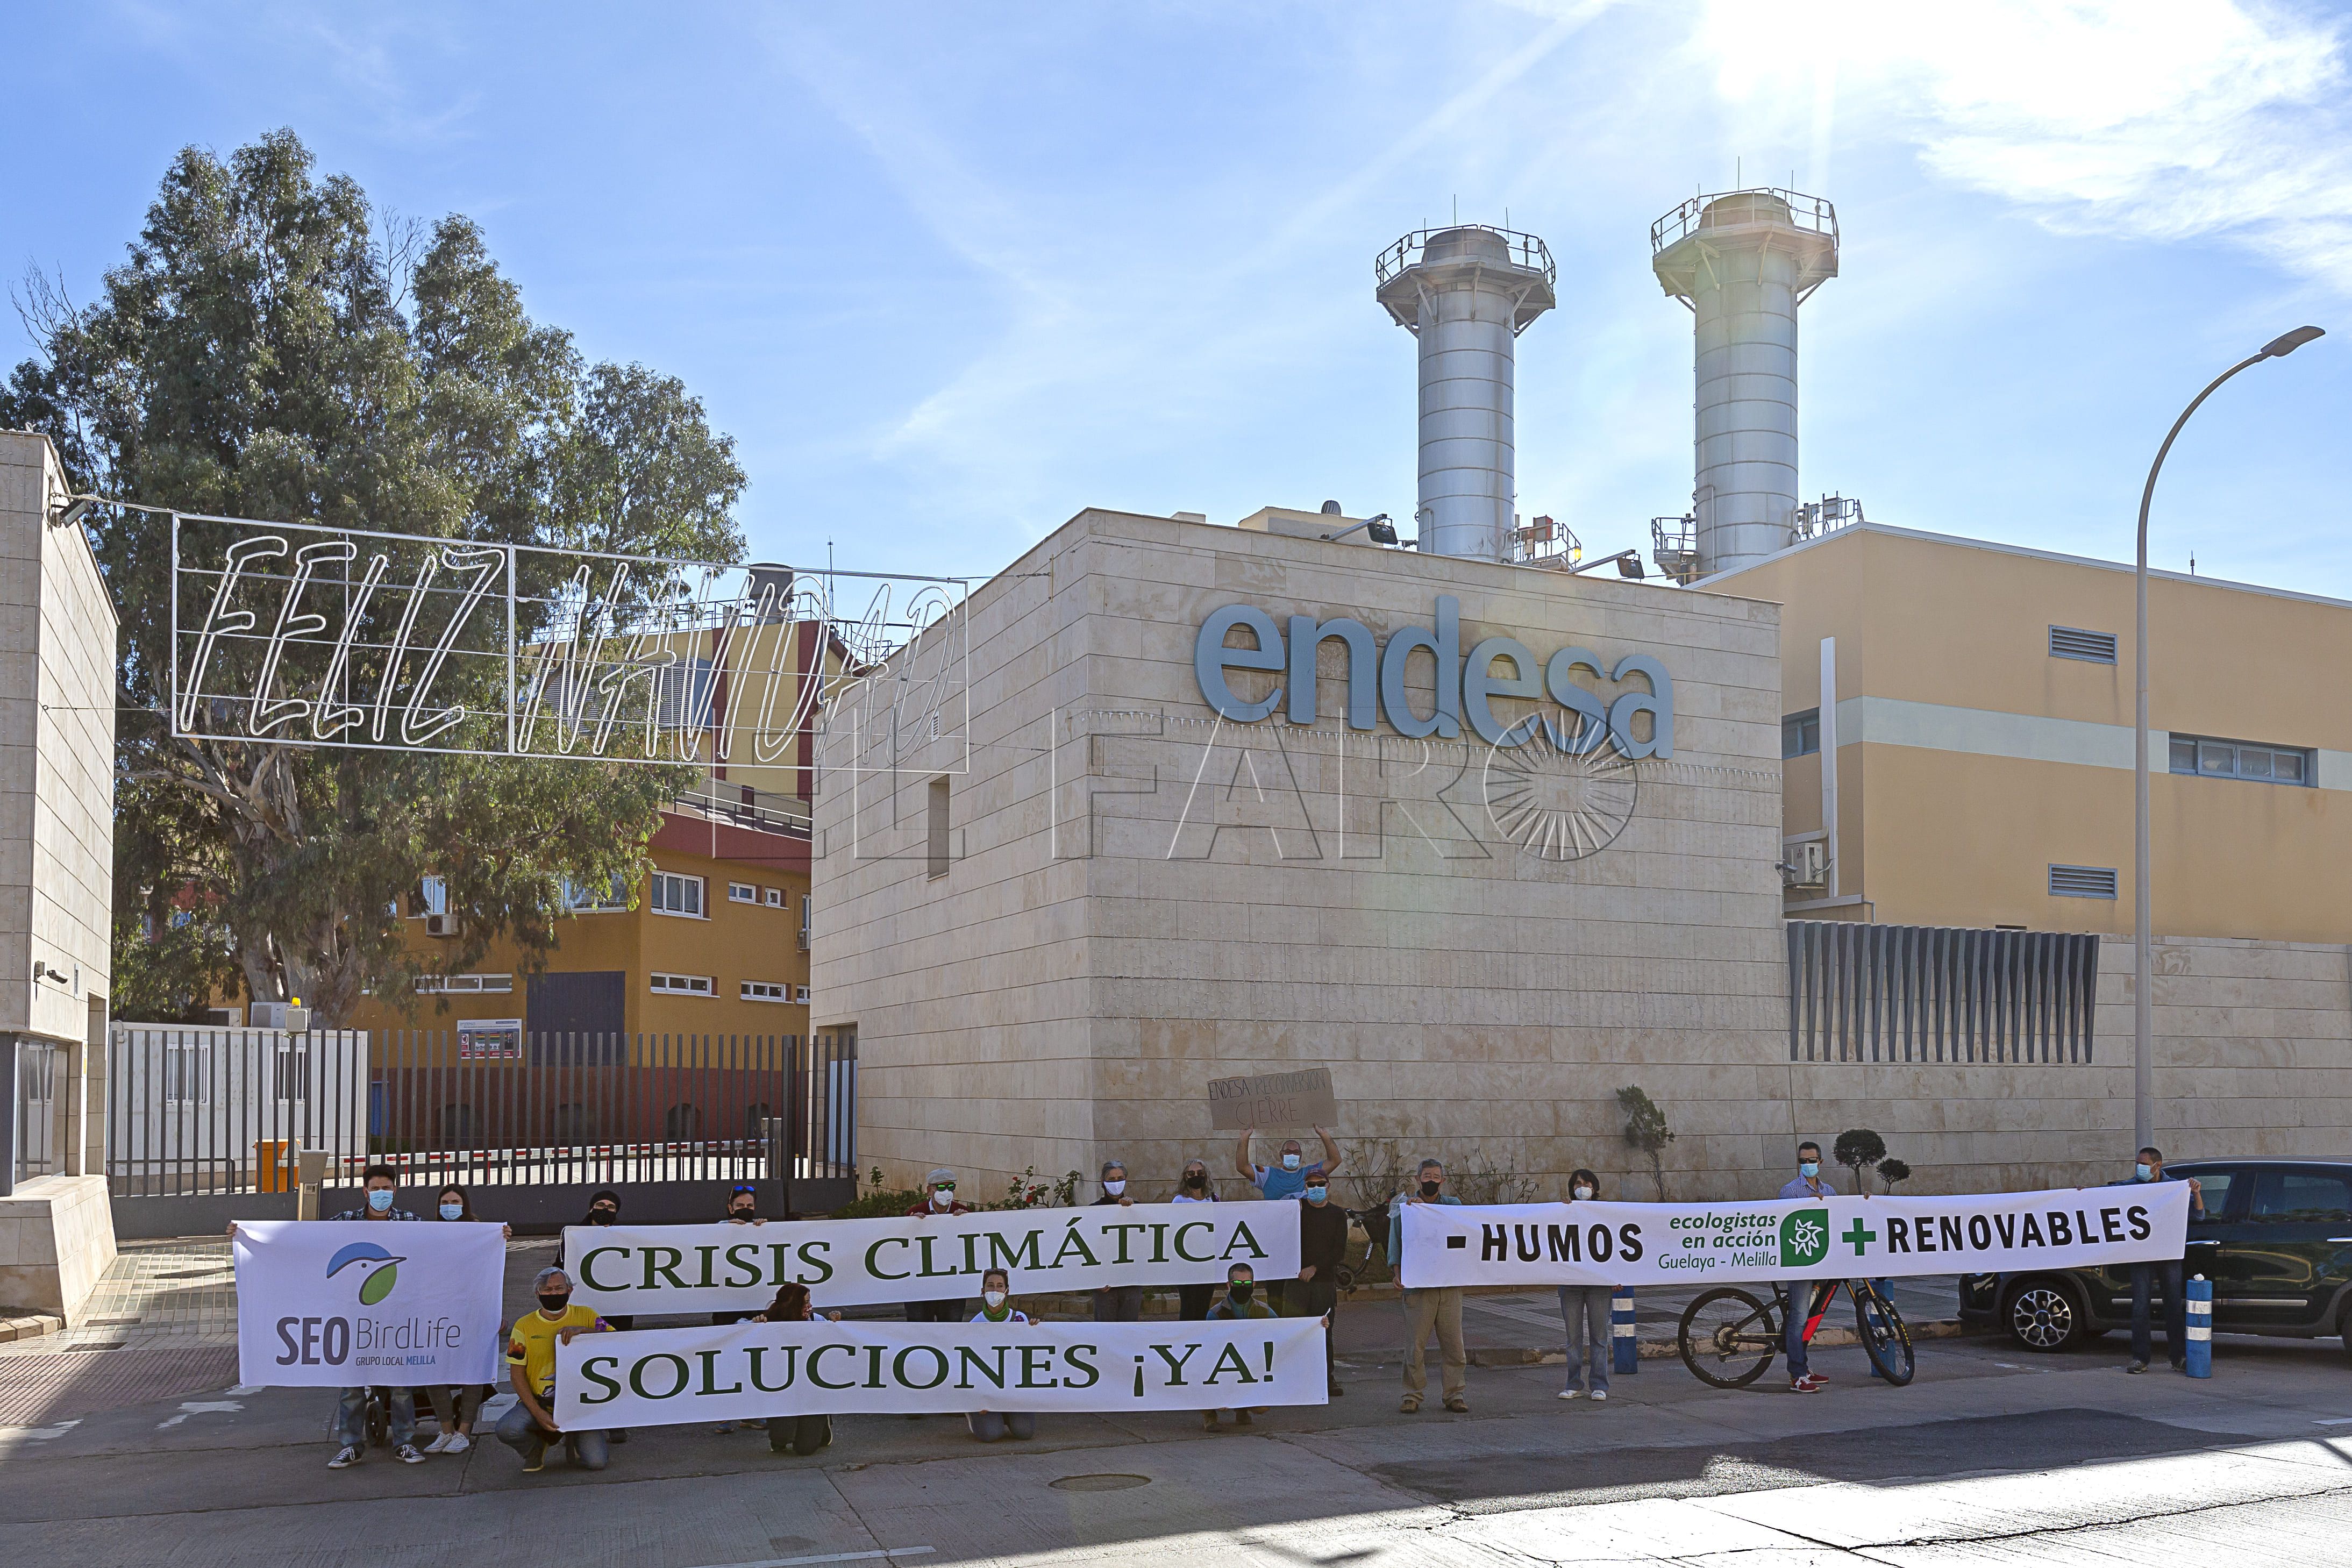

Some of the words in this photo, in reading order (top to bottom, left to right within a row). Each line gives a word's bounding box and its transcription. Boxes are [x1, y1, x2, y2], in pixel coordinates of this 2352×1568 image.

[180, 536, 506, 744] FELIZ
[517, 562, 957, 765] NAVIDAD
[1195, 595, 1674, 759] endesa
[1236, 1098, 1301, 1125] CIERRE
[1670, 1211, 1777, 1234] ecologistas
[1682, 1236, 1705, 1249] en
[1713, 1230, 1776, 1248] acción
[1888, 1206, 2151, 1253] RENOVABLES
[580, 1241, 833, 1292] CRISIS
[864, 1216, 1269, 1280] CLIMÁTICA
[1481, 1223, 1643, 1263] HUMOS
[1658, 1253, 1715, 1273] Guelaya
[1731, 1251, 1777, 1267] Melilla
[276, 1316, 350, 1366] SEO
[357, 1317, 460, 1349] BirdLife
[355, 1357, 381, 1366] GRUPO
[382, 1356, 404, 1366] LOCAL
[406, 1355, 436, 1366] MELILLA
[580, 1344, 1100, 1404] SOLUCIONES
[1134, 1341, 1274, 1397] ¡YA!
